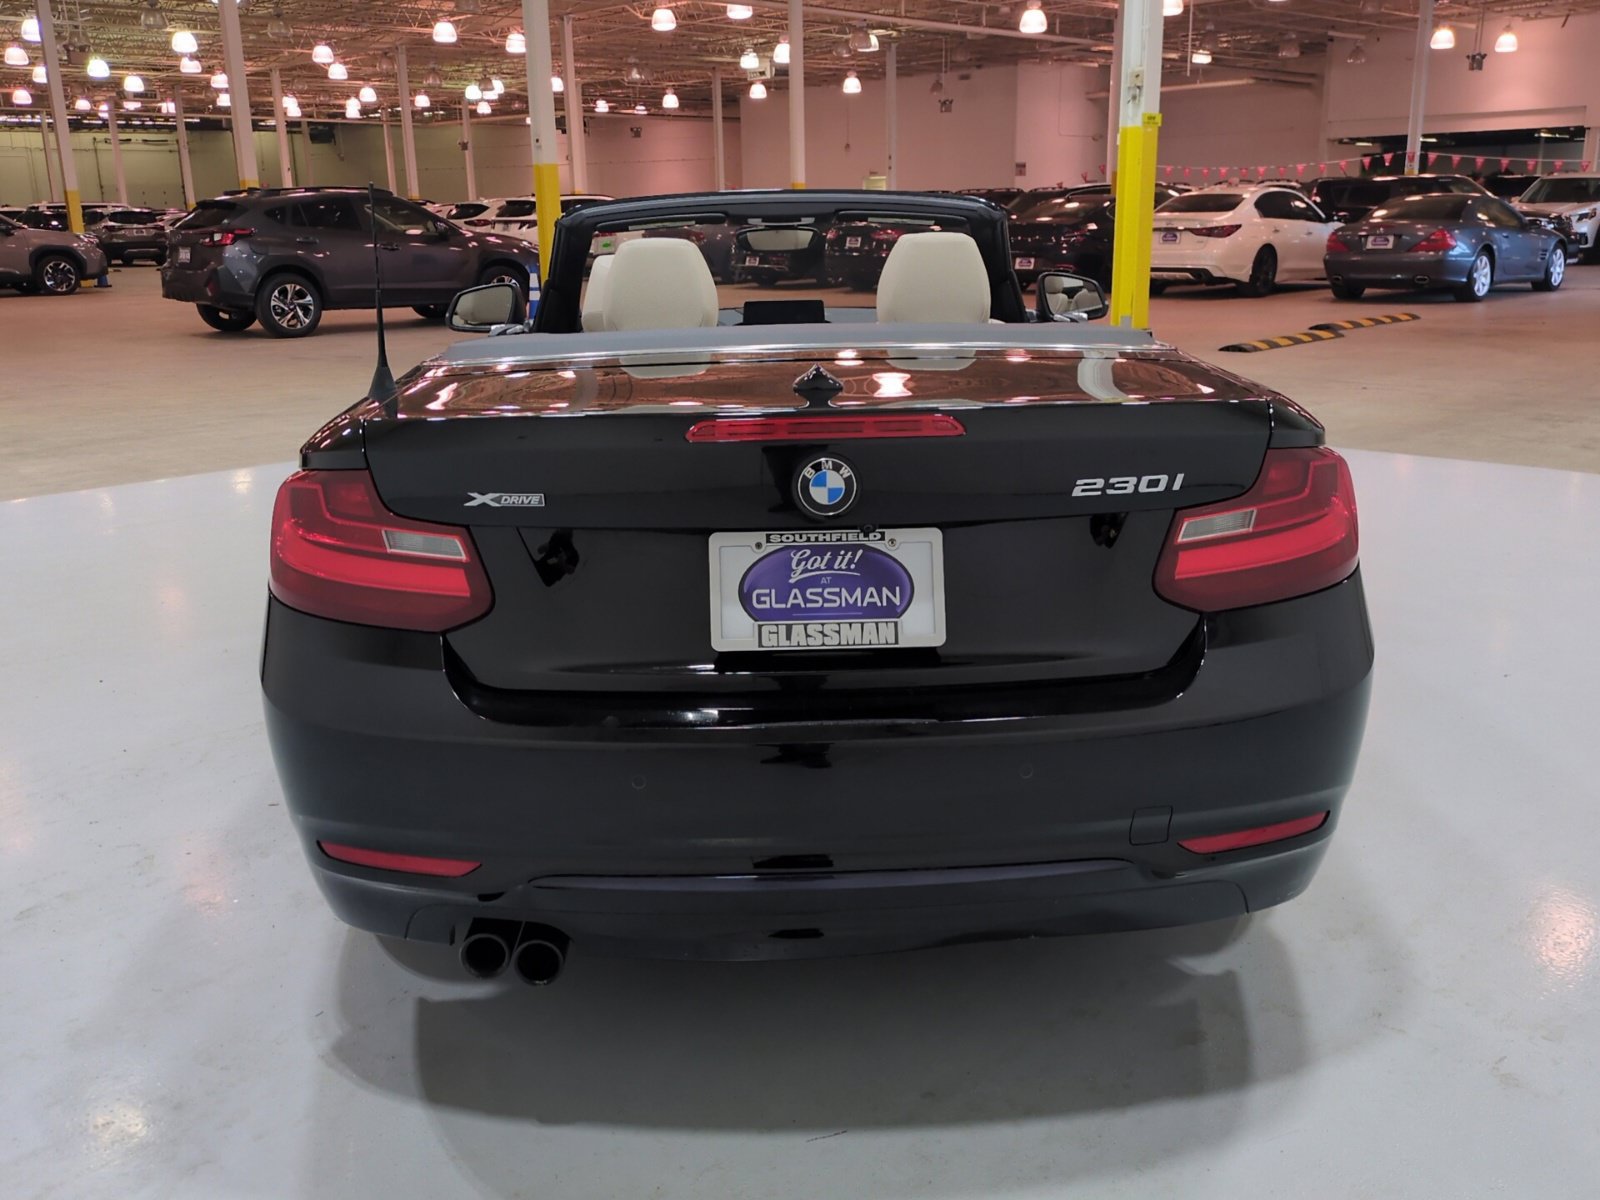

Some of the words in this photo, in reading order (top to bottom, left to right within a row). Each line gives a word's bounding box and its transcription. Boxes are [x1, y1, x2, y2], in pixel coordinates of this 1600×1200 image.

[804, 460, 851, 479] BMW
[769, 532, 882, 543] SOUTHFIELD
[790, 548, 833, 577] Got
[835, 549, 864, 570] it!
[751, 586, 901, 609] GLASSMAN
[761, 621, 896, 648] GLASSMAN
